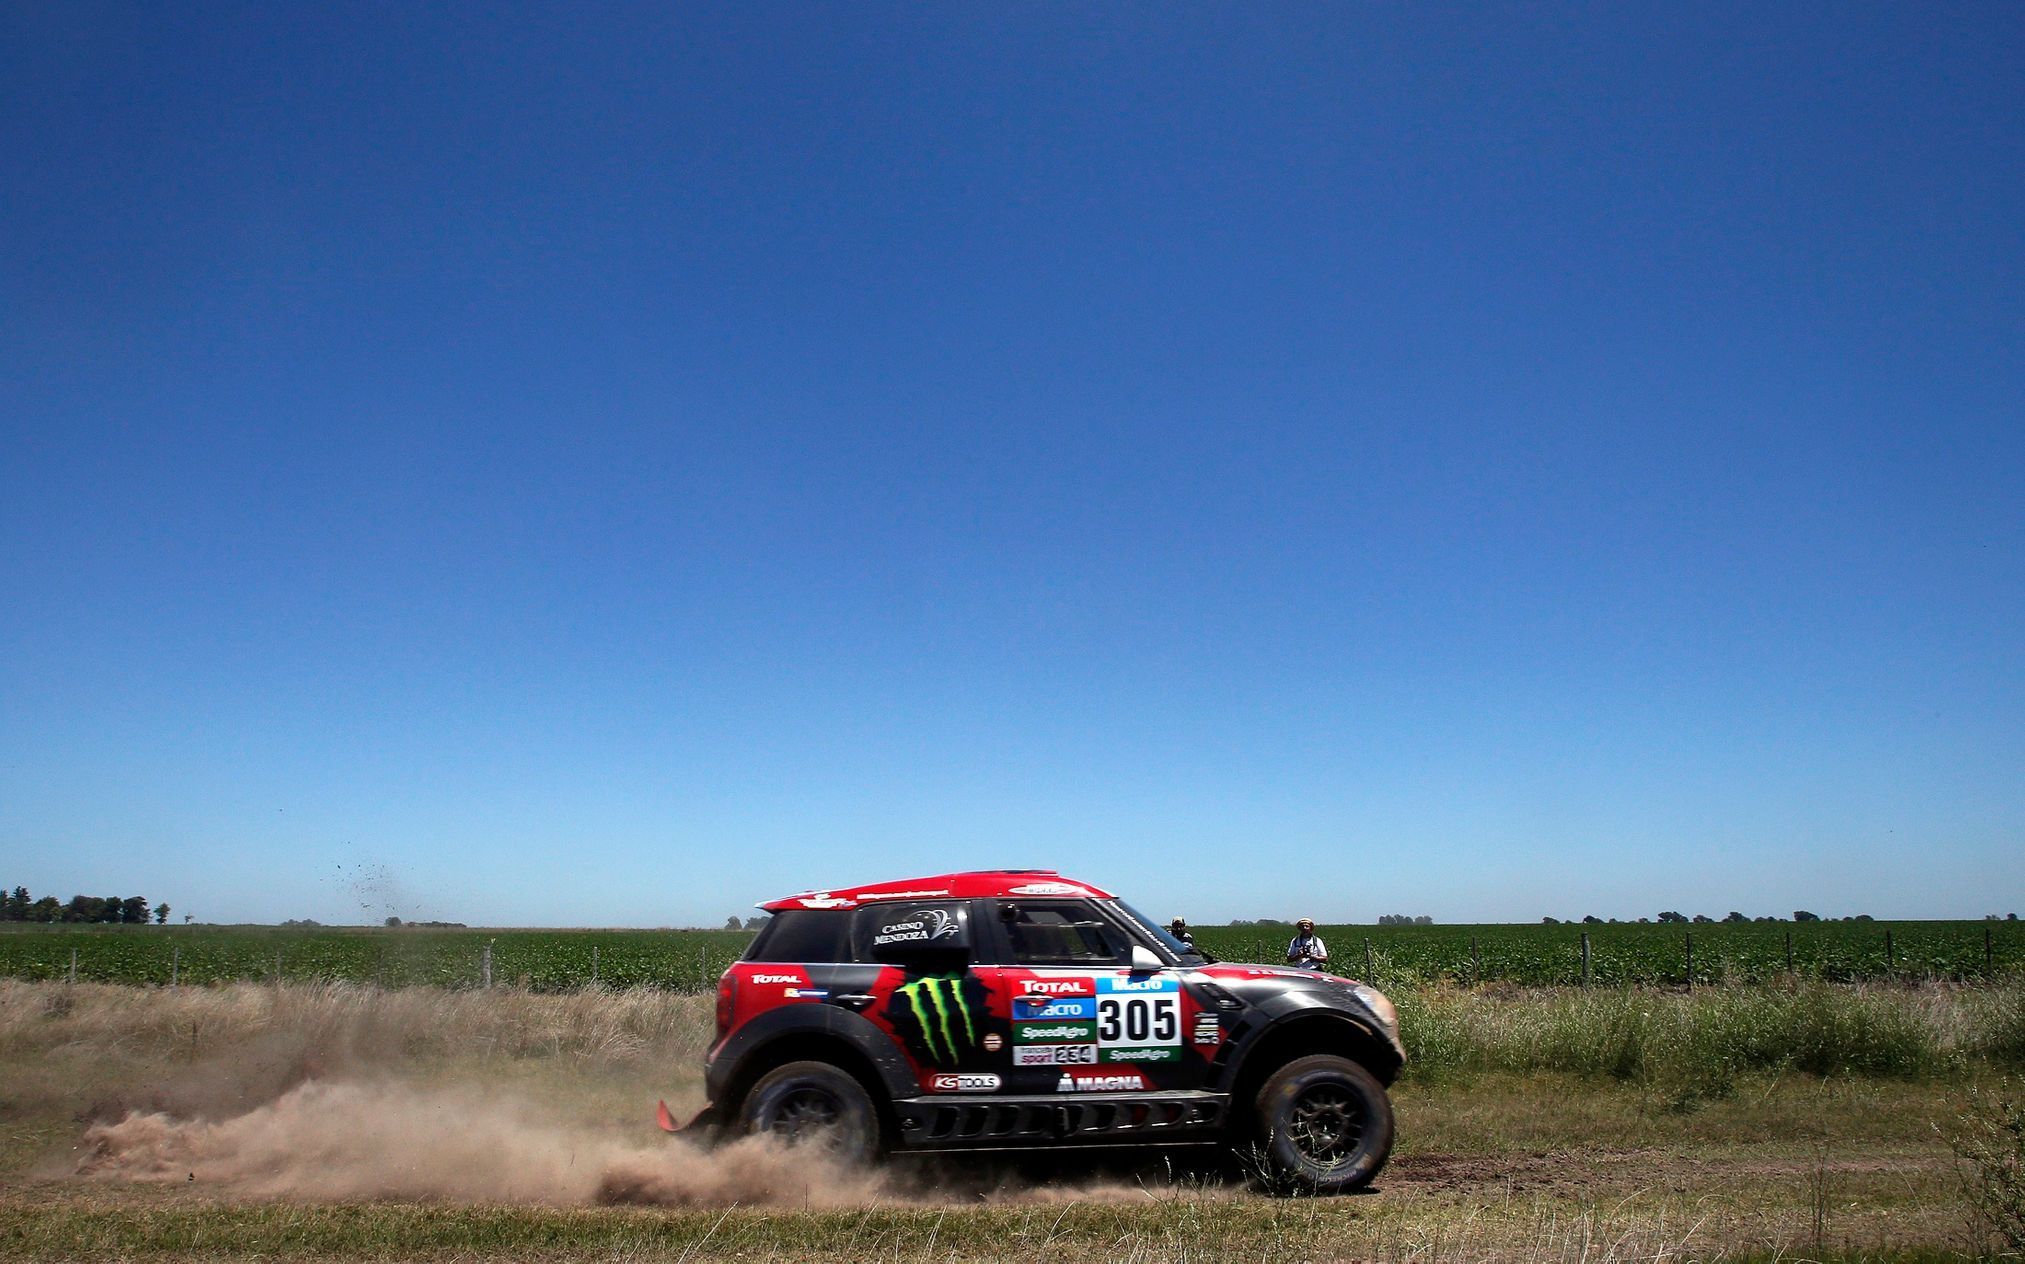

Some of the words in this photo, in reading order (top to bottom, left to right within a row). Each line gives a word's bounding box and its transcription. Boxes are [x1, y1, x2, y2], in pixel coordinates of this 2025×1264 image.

[882, 921, 924, 934] CASINO
[874, 930, 929, 945] MENDOZA
[751, 974, 802, 984] TOTAL
[1019, 980, 1087, 993] TOTAL
[1099, 999, 1176, 1041] 305
[1022, 1026, 1089, 1039] SpeedAgro
[1109, 1049, 1171, 1061] SpeedAgro
[1076, 1076, 1144, 1091] MAGNA
